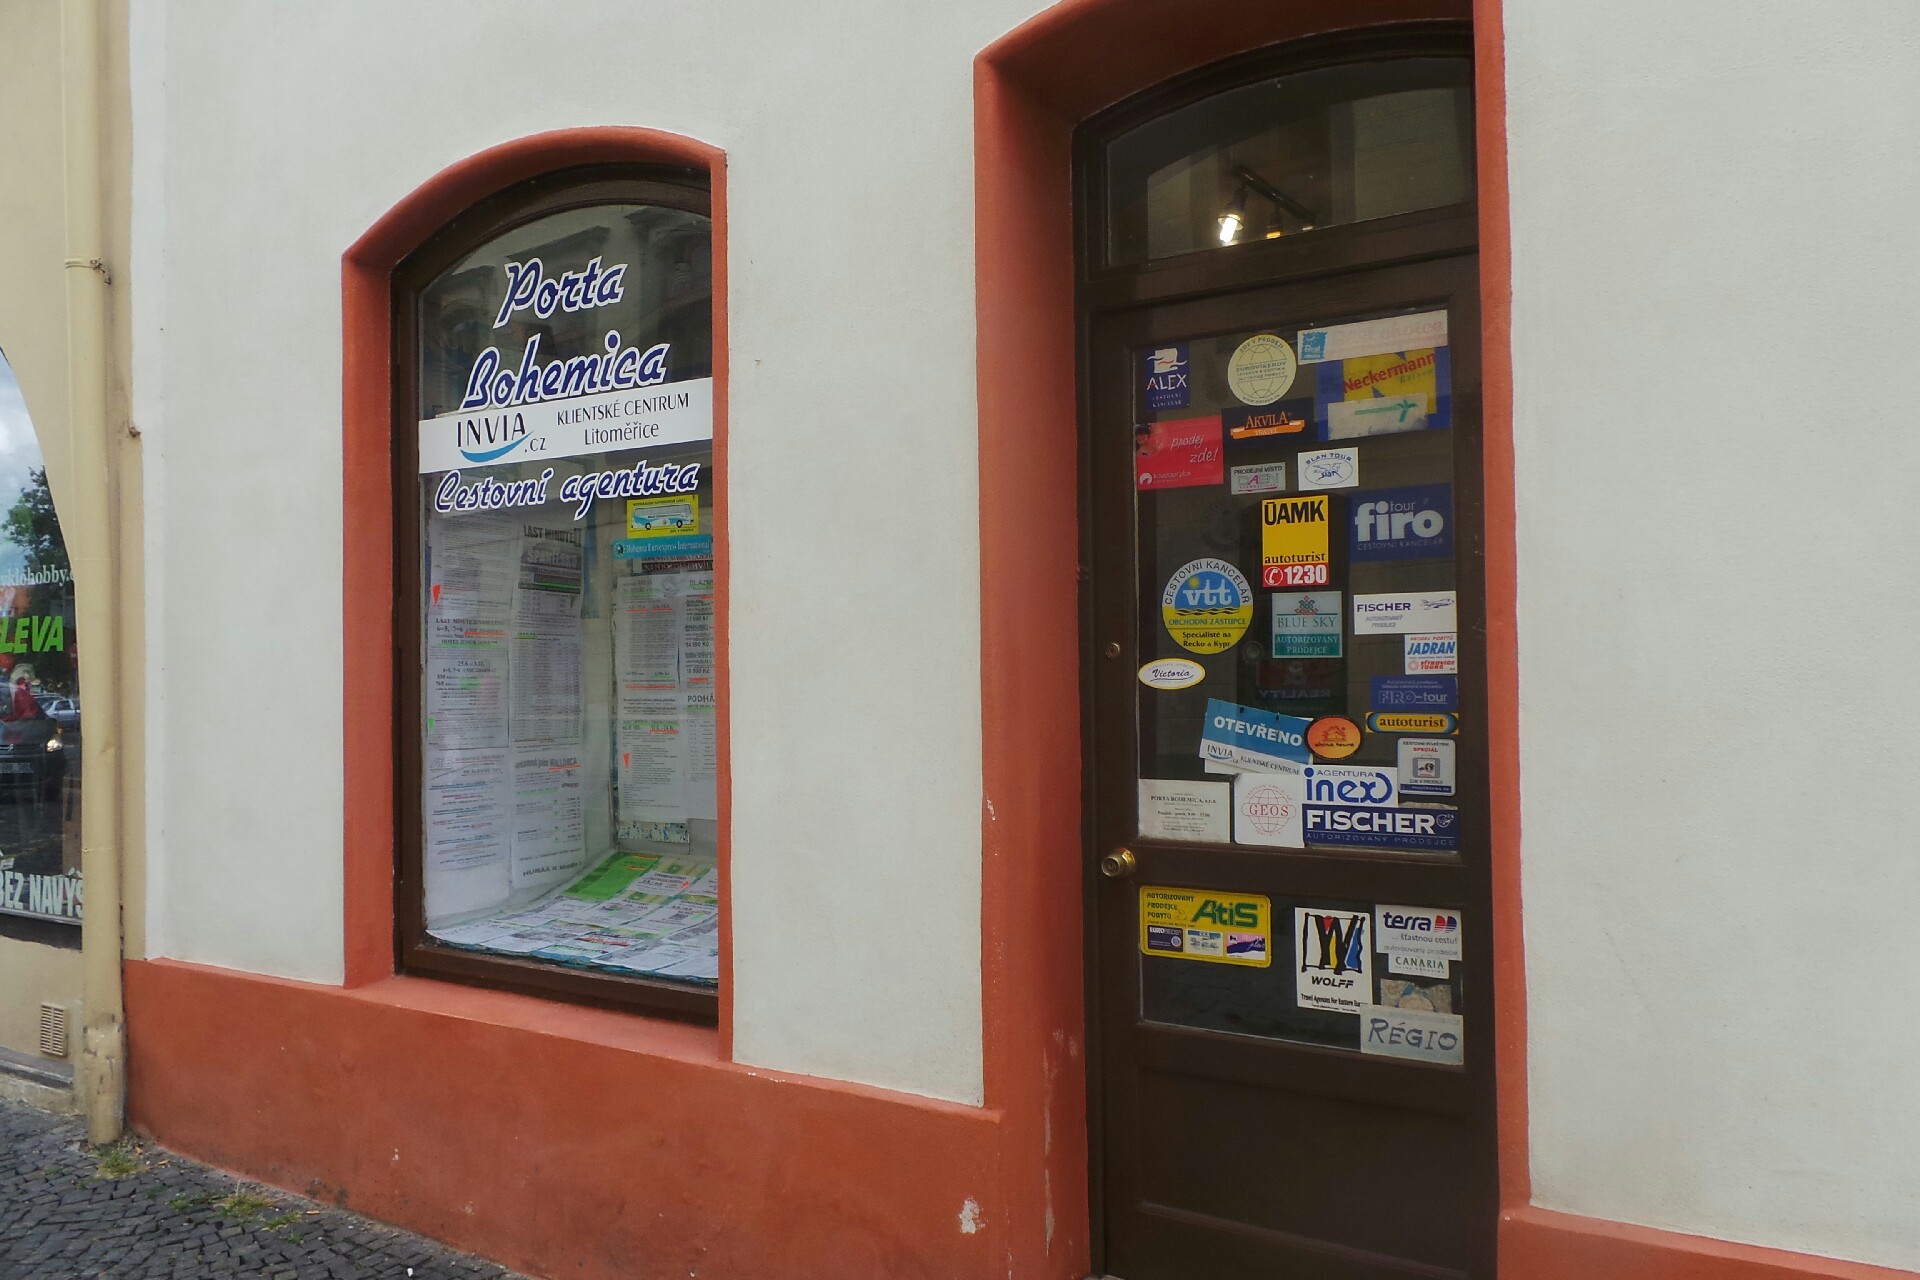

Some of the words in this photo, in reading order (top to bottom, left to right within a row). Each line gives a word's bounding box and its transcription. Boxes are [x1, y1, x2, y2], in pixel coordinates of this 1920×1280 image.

[493, 256, 628, 329] Porta
[458, 330, 671, 413] Bohemica
[1343, 353, 1435, 393] Neckermann
[1146, 373, 1188, 391] ALEX
[557, 400, 620, 426] KLIENTSKÉ
[624, 392, 690, 416] CENTRUM
[1246, 411, 1288, 428] AKVILA
[458, 412, 526, 447] INVIA
[584, 421, 660, 446] Litoměřice
[1170, 434, 1205, 450] prodej
[1190, 448, 1219, 464] zde!
[1330, 453, 1352, 462] TOUR
[560, 459, 702, 521] agentura
[1390, 501, 1415, 512] tour
[1354, 501, 1444, 542] firo
[1264, 551, 1326, 564] autoturist
[1284, 564, 1327, 585] 1230
[1165, 561, 1203, 605] CESTOVNÍ
[1183, 580, 1233, 607] vtt
[1357, 603, 1411, 612] FISCHER
[1277, 617, 1308, 628] BLUE
[1313, 616, 1337, 628] SKY
[1287, 646, 1328, 655] PRODEJCE
[1407, 641, 1456, 655] JADRAN
[1151, 668, 1190, 678] Victoria
[1379, 717, 1446, 728] autoturist
[1213, 715, 1304, 748] OTEVŘENO
[1207, 744, 1233, 758] INVIA
[1316, 769, 1375, 778] AGENTURA
[1303, 767, 1393, 804] inex
[1249, 804, 1289, 817] GEOS
[1306, 809, 1436, 835] FISCHER
[1394, 836, 1454, 846] PRODEJCE
[1146, 902, 1178, 911] PRODEJCE
[1383, 911, 1432, 932] terra
[1395, 956, 1444, 970] CANARIA
[1311, 976, 1354, 988] WOLFF
[1367, 1018, 1459, 1051] RÉGIO
